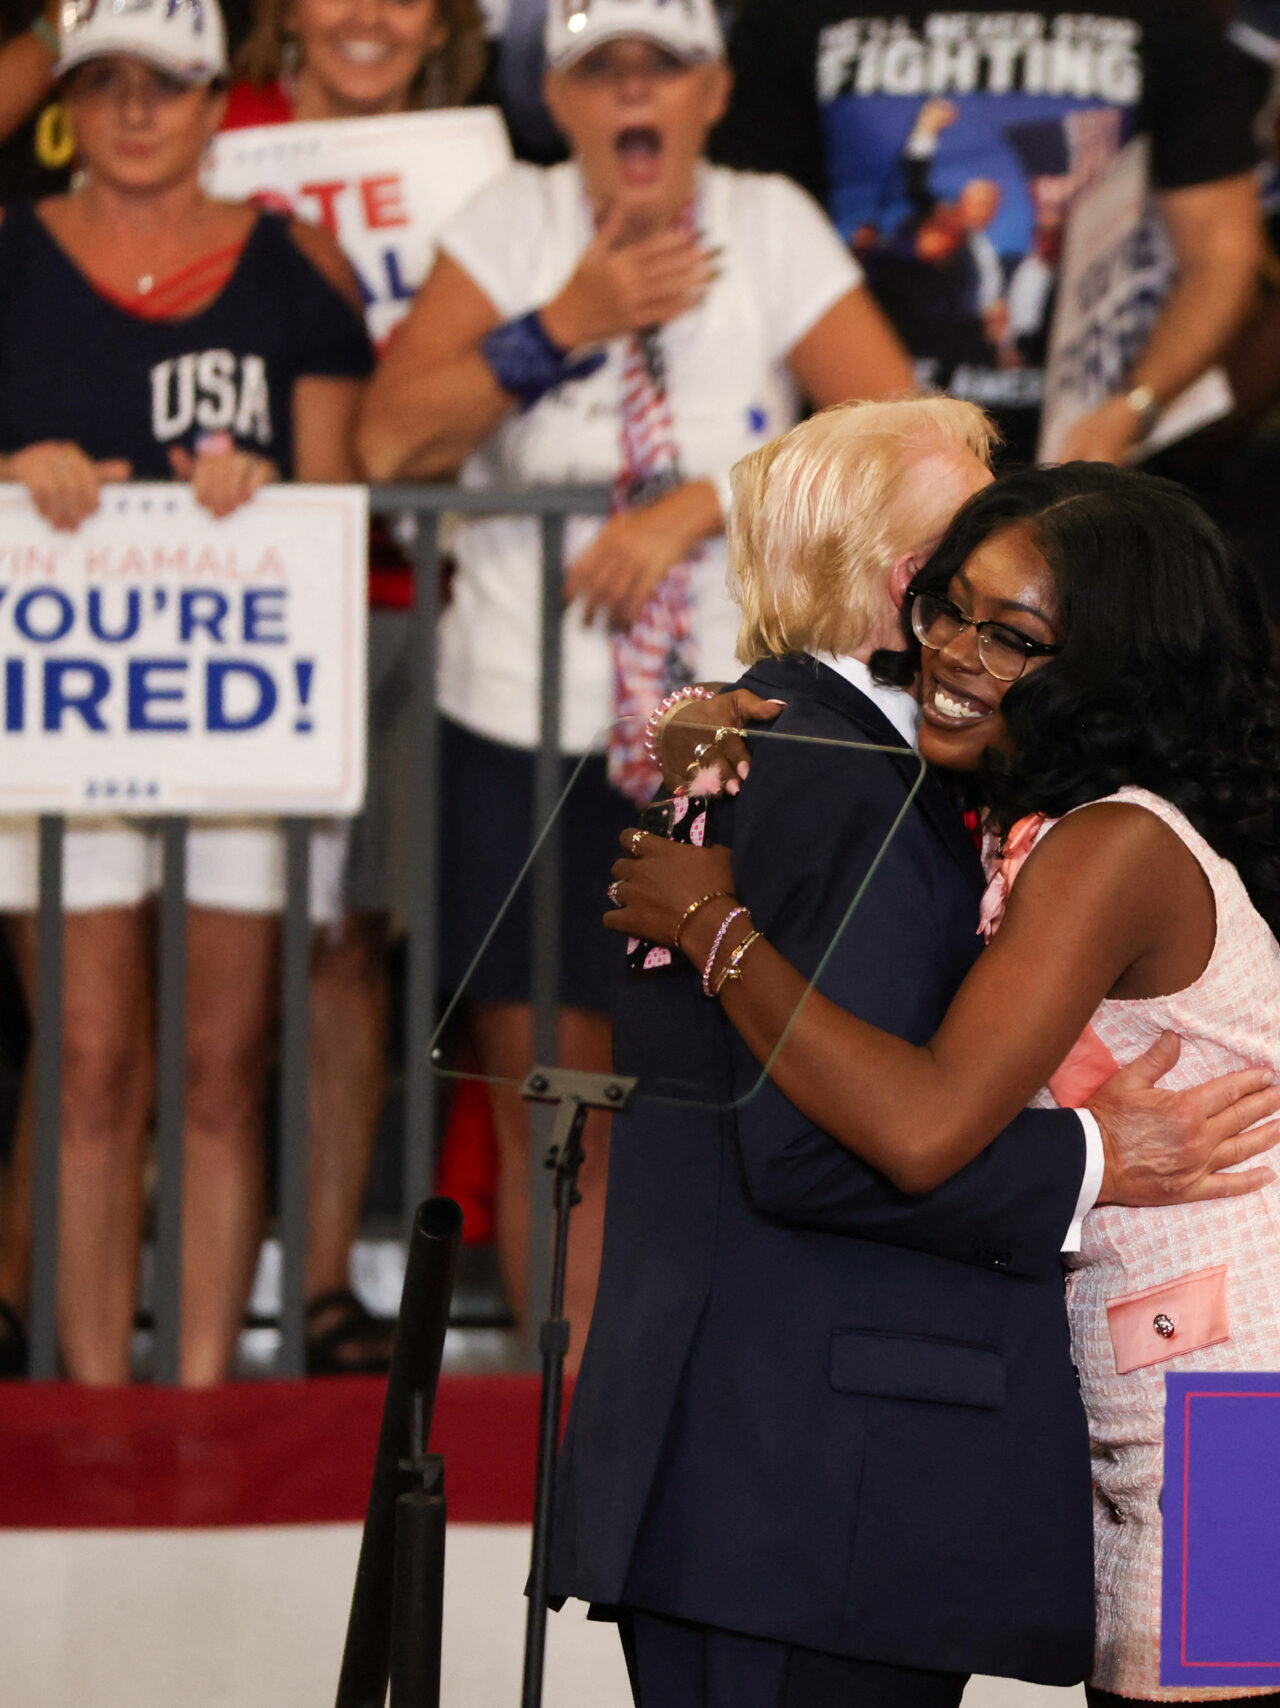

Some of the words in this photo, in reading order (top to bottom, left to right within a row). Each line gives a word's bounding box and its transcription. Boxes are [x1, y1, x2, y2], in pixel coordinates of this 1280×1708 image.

[816, 38, 1143, 105] FIGHTING
[151, 348, 273, 444] USA
[85, 546, 286, 578] KAMALA
[0, 585, 288, 643] OU'RE
[4, 657, 315, 735] IRED!
